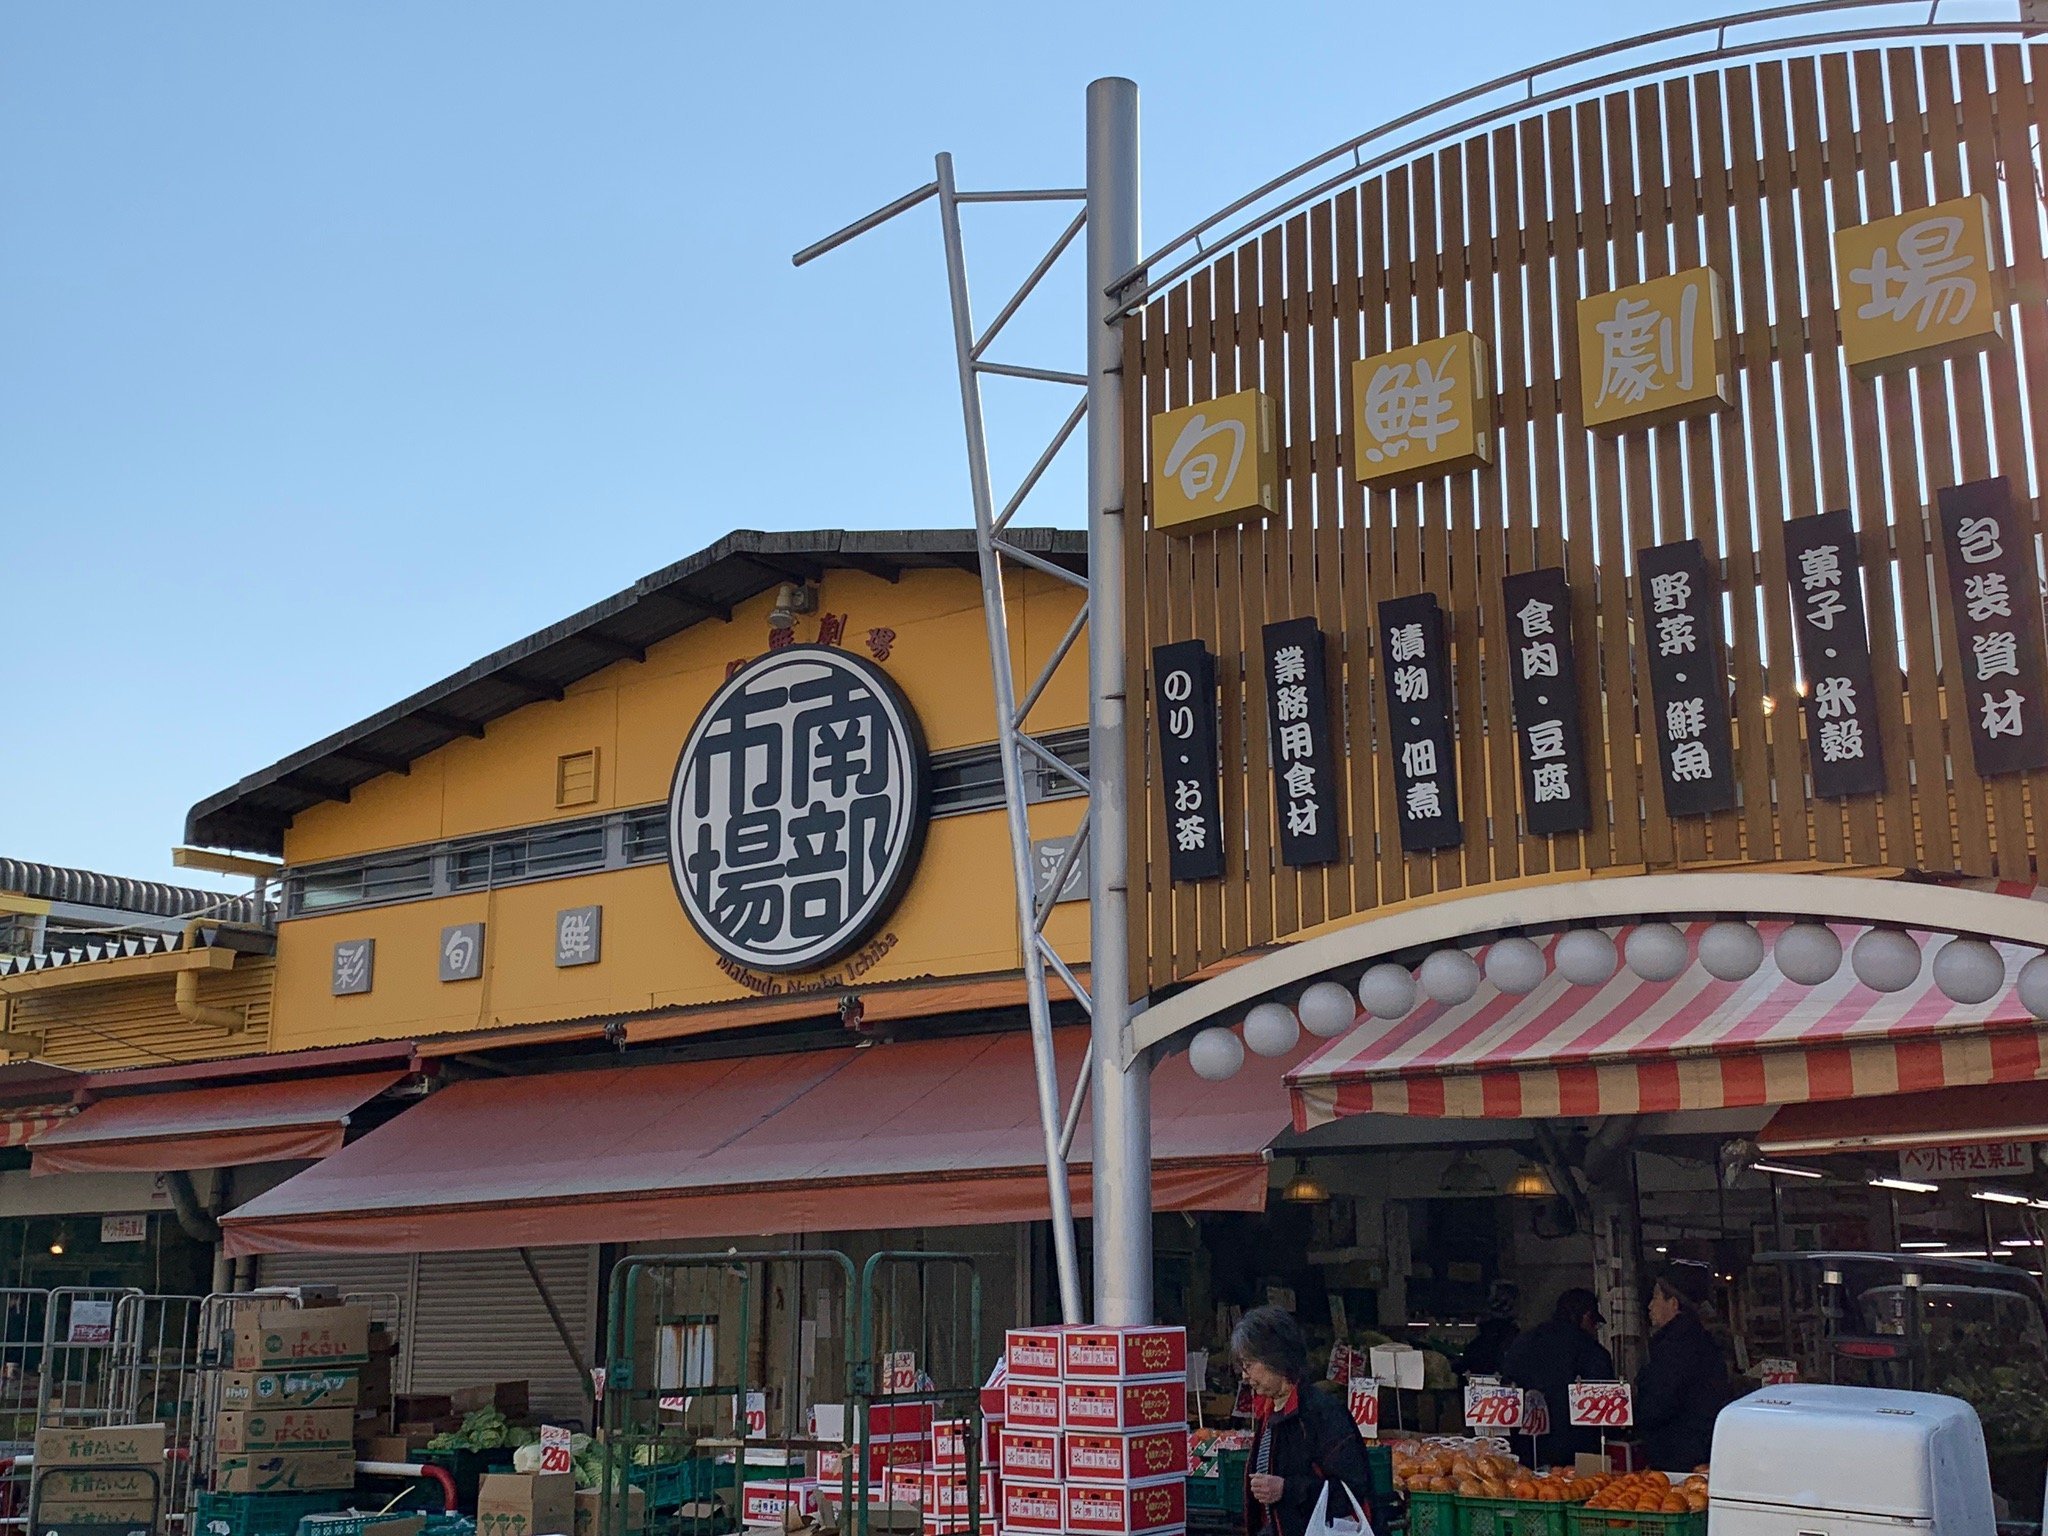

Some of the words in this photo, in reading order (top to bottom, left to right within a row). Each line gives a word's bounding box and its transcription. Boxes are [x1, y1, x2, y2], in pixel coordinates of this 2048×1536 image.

[1163, 413, 1247, 503] 旬
[1363, 345, 1461, 463] 鮮
[1595, 283, 1699, 408] 劇
[1847, 216, 1977, 332] 場
[1956, 517, 2026, 739] 包装資材
[1274, 646, 1320, 838] 業務用食材
[335, 945, 364, 989] 彩
[445, 930, 473, 974] 旬
[560, 911, 592, 959] 鮮
[845, 932, 899, 981] Ichiba
[1467, 1395, 1520, 1426] 498
[1574, 1396, 1630, 1425] 298
